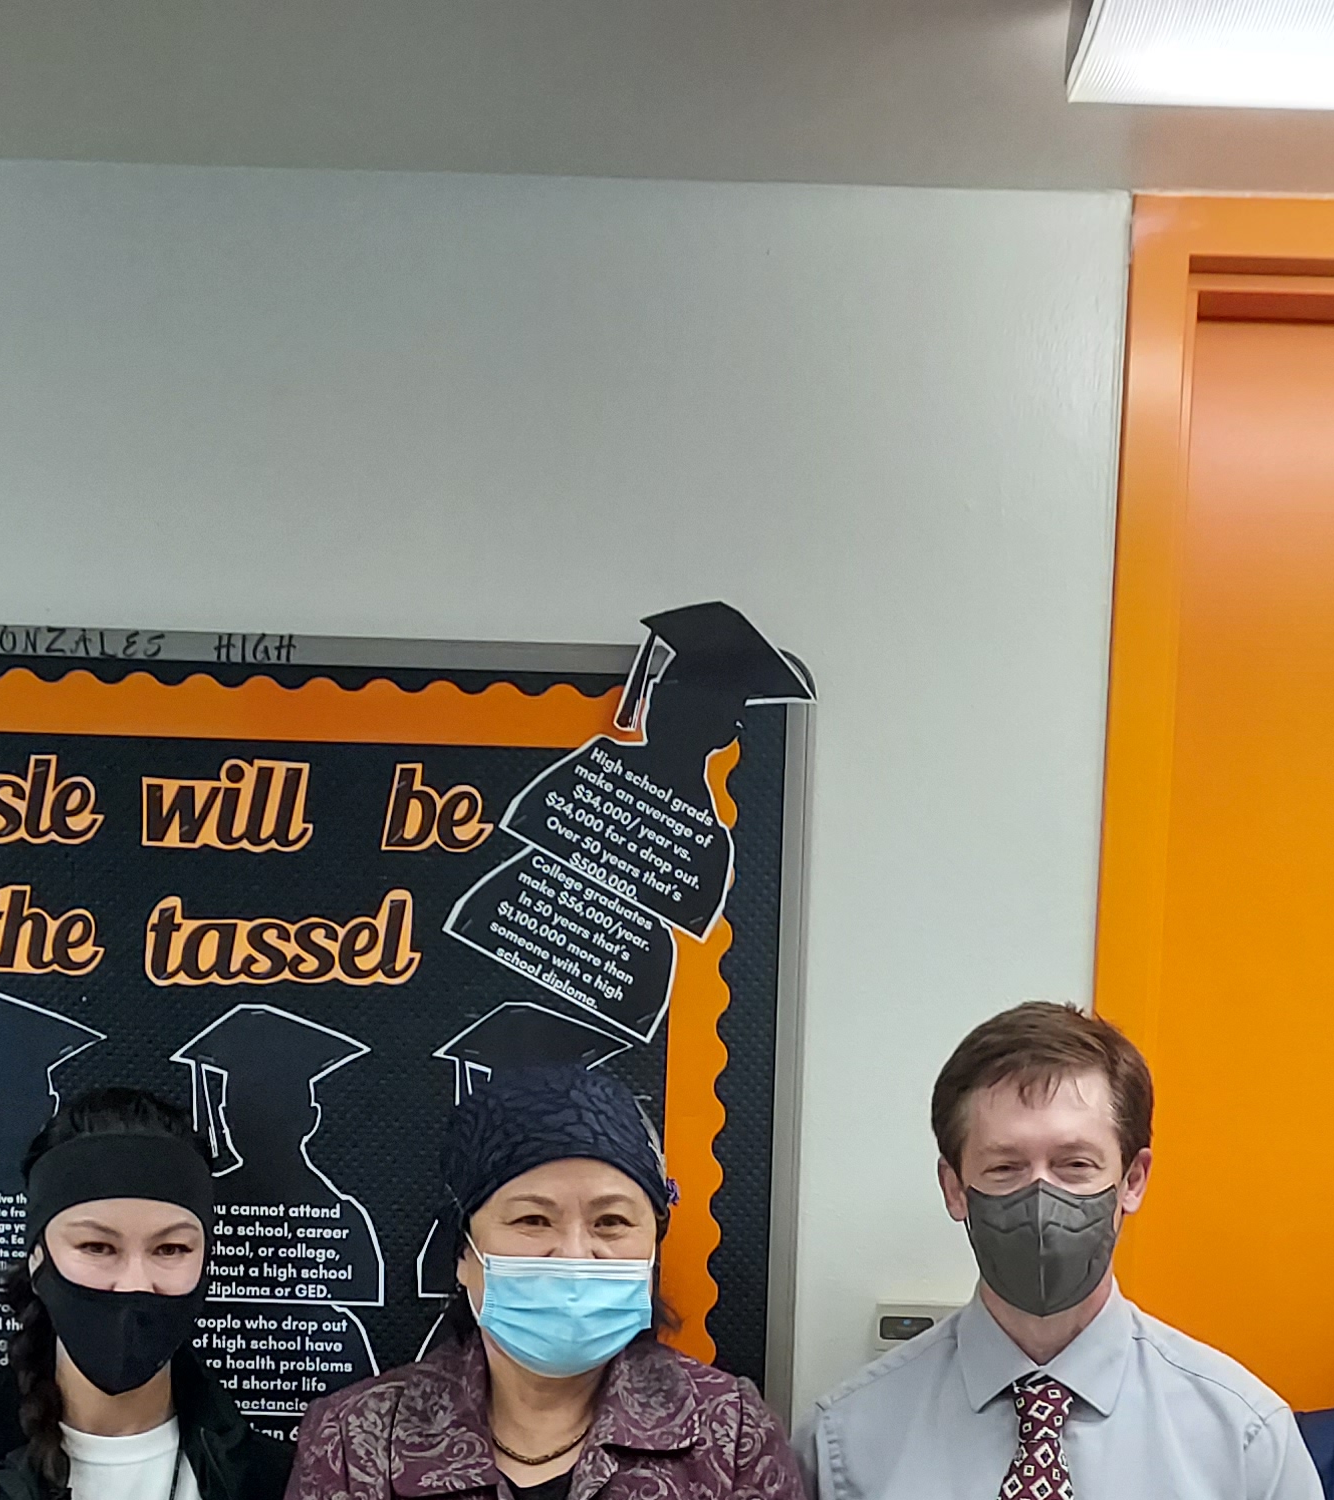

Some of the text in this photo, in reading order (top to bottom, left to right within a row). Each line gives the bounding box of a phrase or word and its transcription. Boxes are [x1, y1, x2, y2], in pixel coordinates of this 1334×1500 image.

[213, 633, 298, 663] HIGH
[141, 759, 314, 852] will
[381, 763, 494, 852] be
[574, 764, 714, 849] make an average of
[590, 747, 714, 827] High school grads
[545, 790, 700, 890] $24,000 for a drop out.
[546, 816, 683, 902] Over 50 years that's
[637, 824, 671, 849] year
[674, 846, 693, 862] vs.
[531, 856, 654, 932] College graduates
[569, 851, 639, 901] $500,000.
[518, 872, 651, 952] make $56,000/year.
[518, 890, 631, 962] In 50 years that's
[145, 888, 422, 986] tassel
[497, 900, 635, 986] $1,100,000 more than
[489, 922, 625, 1002] someone with a high
[496, 947, 599, 1009] school diploma.
[230, 1204, 285, 1217] cannot
[288, 1203, 341, 1218] attend
[237, 1221, 293, 1240] school,
[296, 1228, 349, 1240] career
[11, 1250, 27, 1258] co
[207, 1260, 353, 1282] hout a high school
[257, 1246, 275, 1258] or
[278, 1242, 341, 1262] college,
[207, 1282, 332, 1299] diploma or GED.
[192, 1333, 343, 1352] of high school have
[194, 1313, 349, 1335] eople who drop out
[226, 1355, 276, 1370] health
[279, 1356, 353, 1374] problems
[242, 1374, 298, 1390] shorter
[301, 1376, 327, 1392] life
[234, 1398, 309, 1412] ectancie
